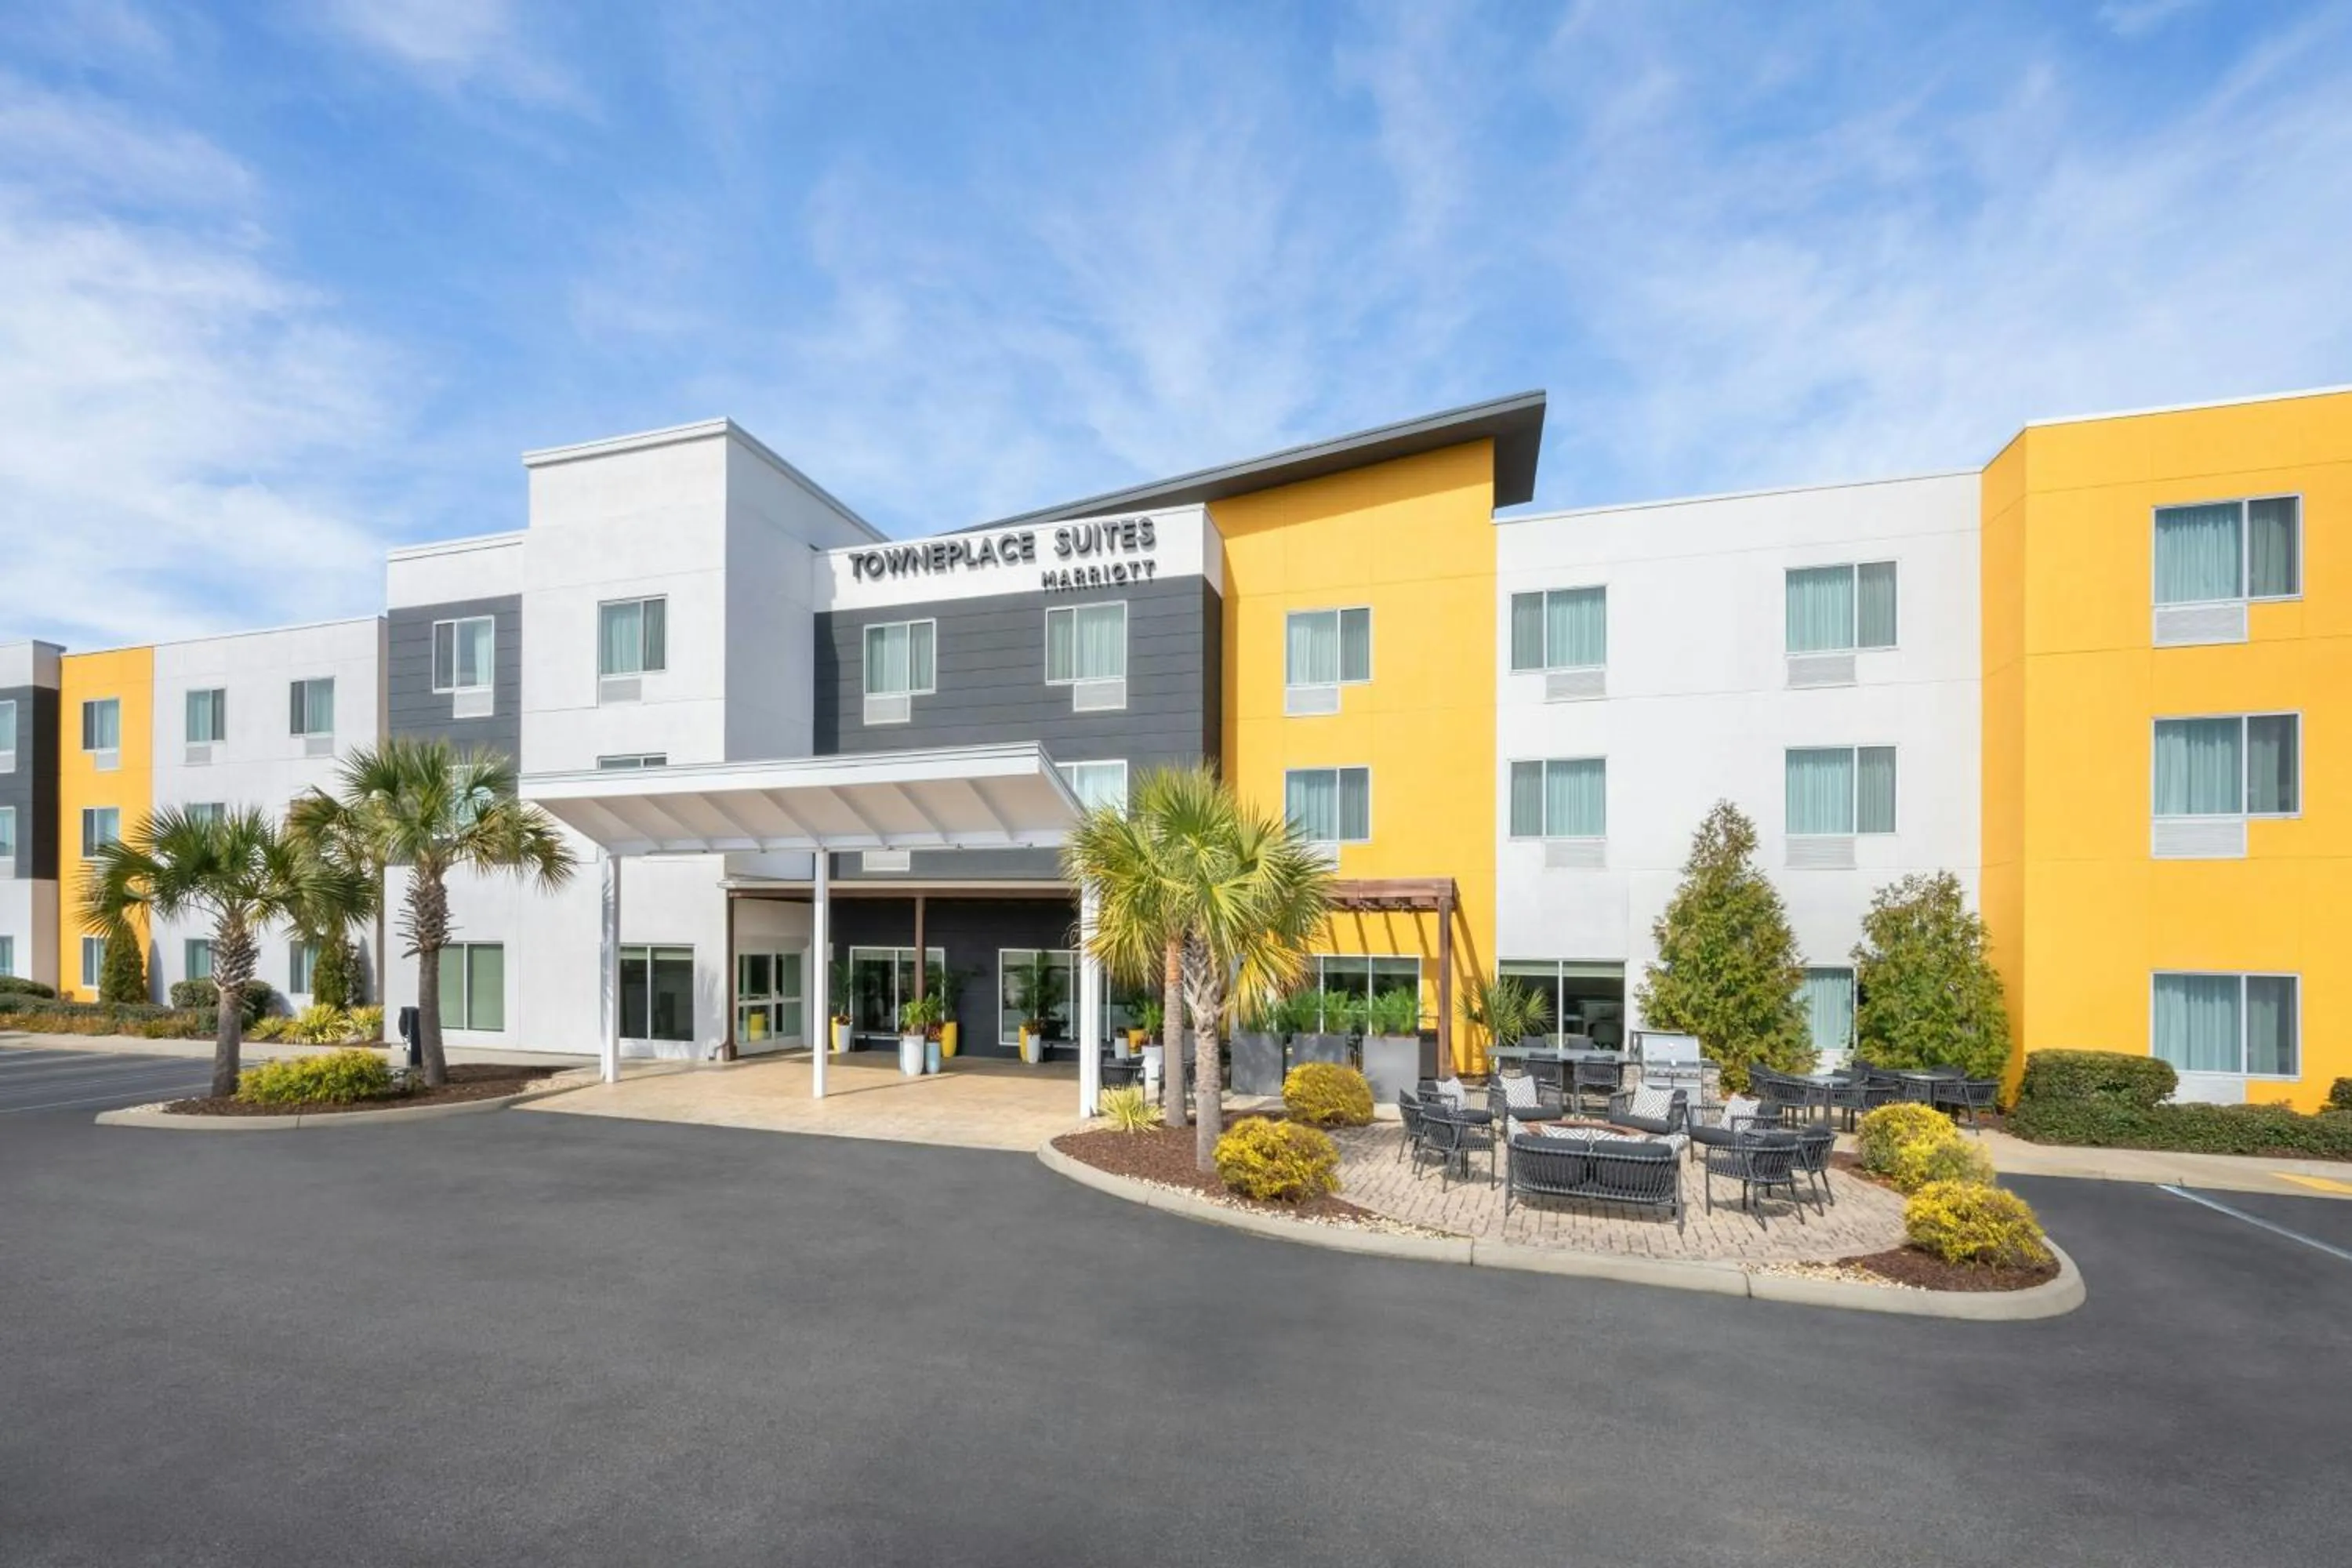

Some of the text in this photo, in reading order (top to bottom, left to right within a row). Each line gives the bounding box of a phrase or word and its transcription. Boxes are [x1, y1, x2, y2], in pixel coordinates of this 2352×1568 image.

[849, 517, 1156, 579] TOWNEPLACE SUITES
[1041, 560, 1156, 590] MARRIOTT
